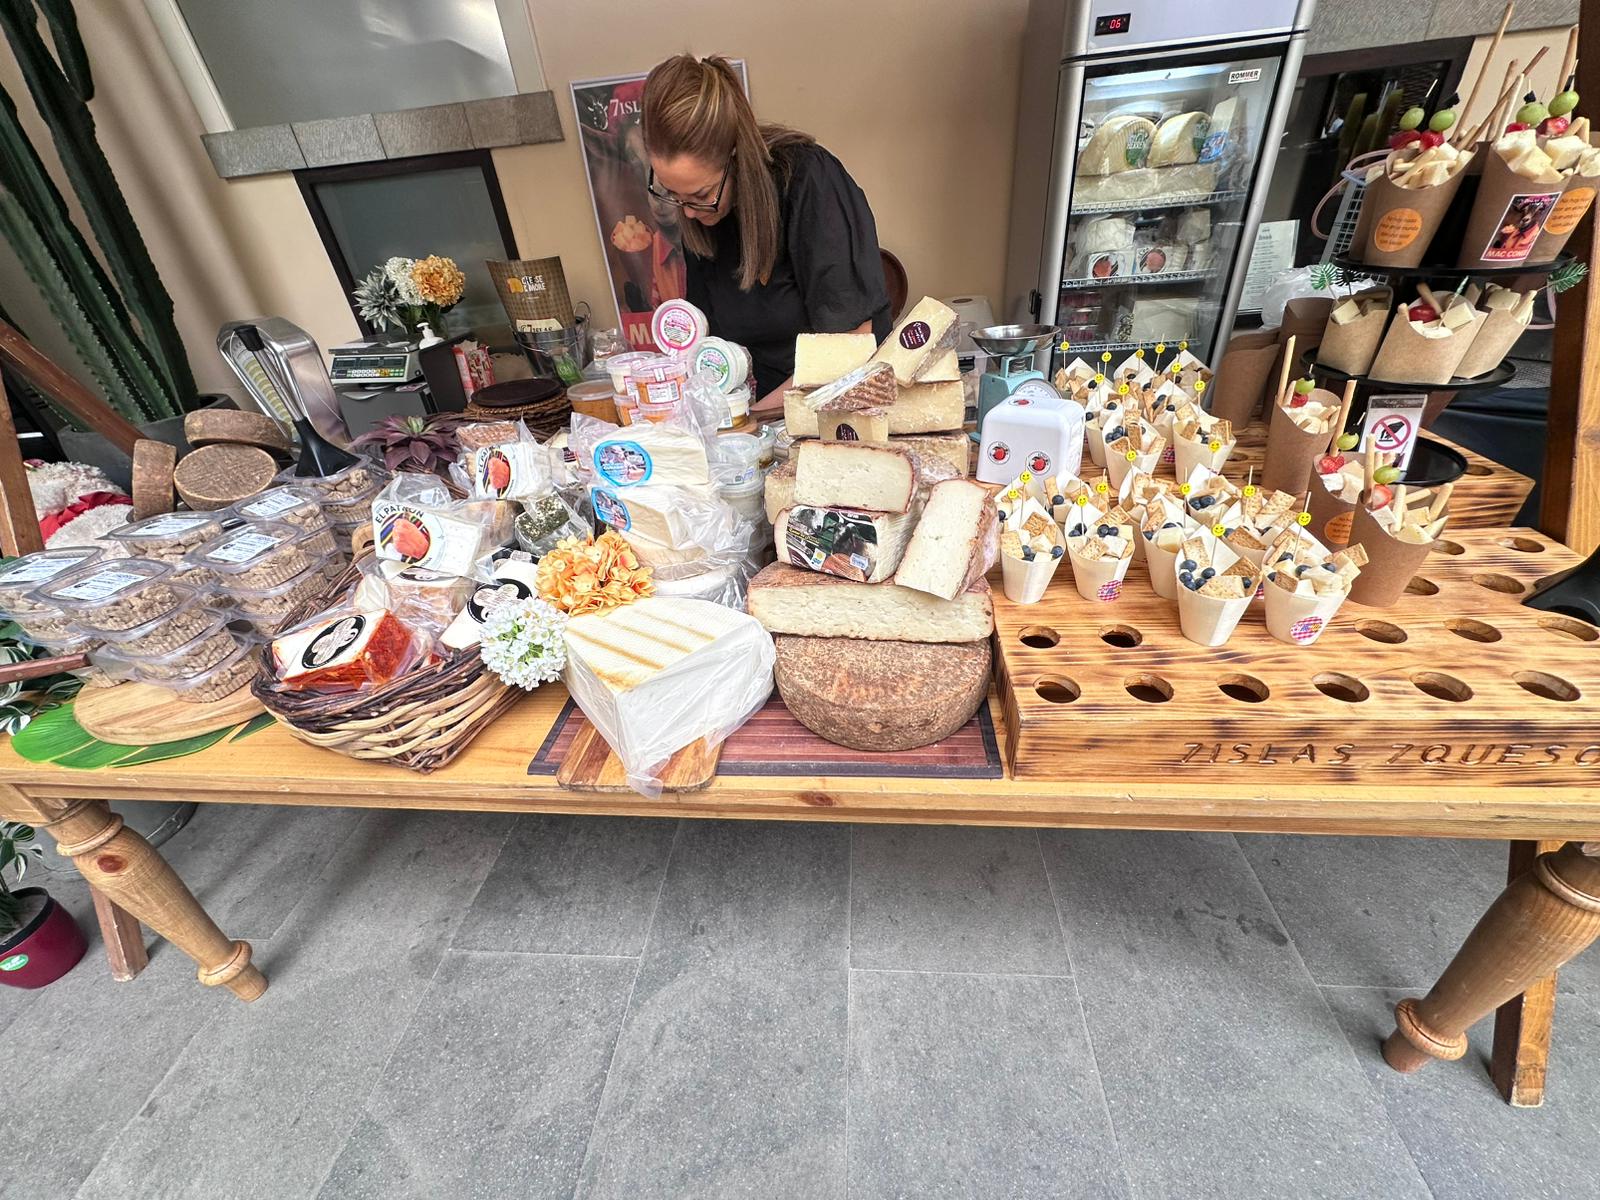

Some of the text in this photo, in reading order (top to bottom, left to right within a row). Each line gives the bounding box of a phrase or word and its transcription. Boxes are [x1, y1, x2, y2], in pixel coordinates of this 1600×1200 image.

[1109, 18, 1122, 29] 06
[1230, 70, 1259, 80] ROMMER
[609, 98, 642, 117] 7ISL
[629, 323, 656, 345] M
[375, 512, 386, 524] EL
